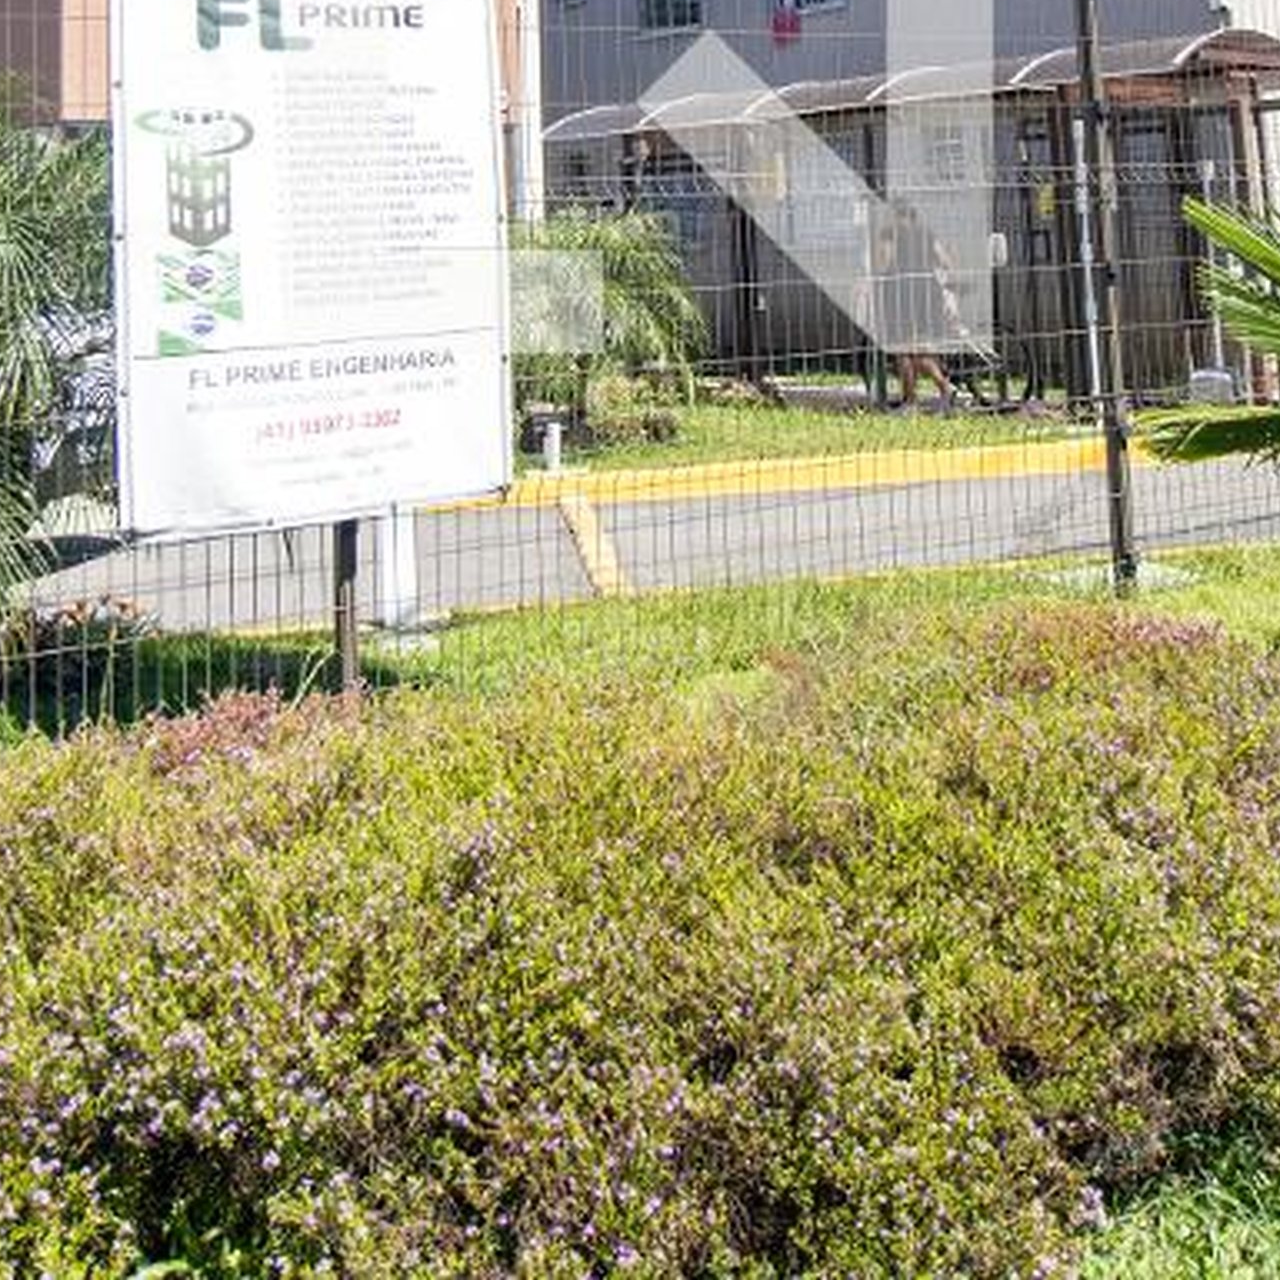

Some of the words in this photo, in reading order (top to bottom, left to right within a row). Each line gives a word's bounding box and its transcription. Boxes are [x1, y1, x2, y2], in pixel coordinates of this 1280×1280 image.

[298, 4, 425, 30] PRIME
[189, 368, 218, 389] FL
[226, 359, 303, 385] PRIME
[309, 348, 457, 380] ENGENHARIA
